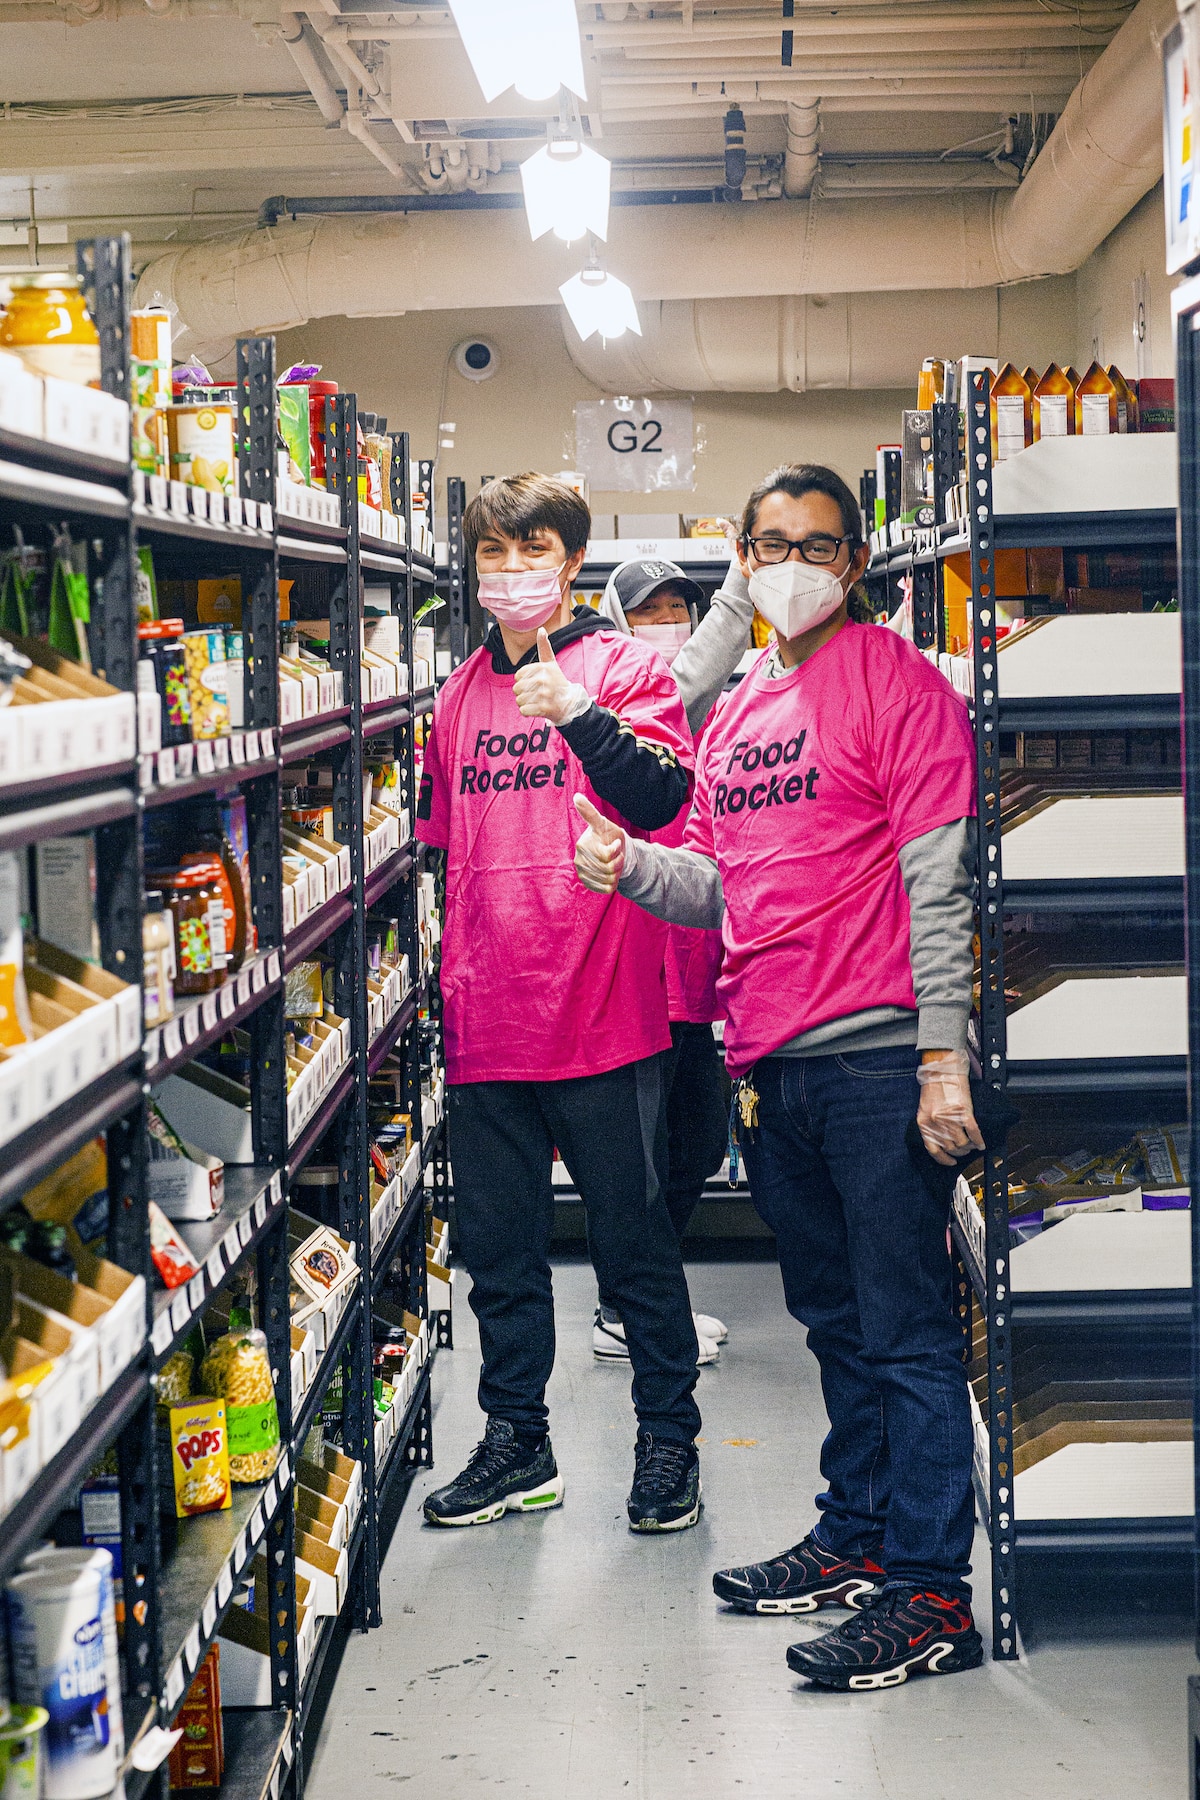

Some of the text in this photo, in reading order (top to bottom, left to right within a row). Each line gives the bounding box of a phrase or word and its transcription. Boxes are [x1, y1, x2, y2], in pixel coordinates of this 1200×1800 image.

[607, 420, 663, 453] G2
[474, 724, 551, 758] Food
[726, 729, 807, 775] Food
[460, 759, 566, 795] Rocket
[713, 767, 820, 818] Rocket
[176, 1430, 220, 1471] POPS
